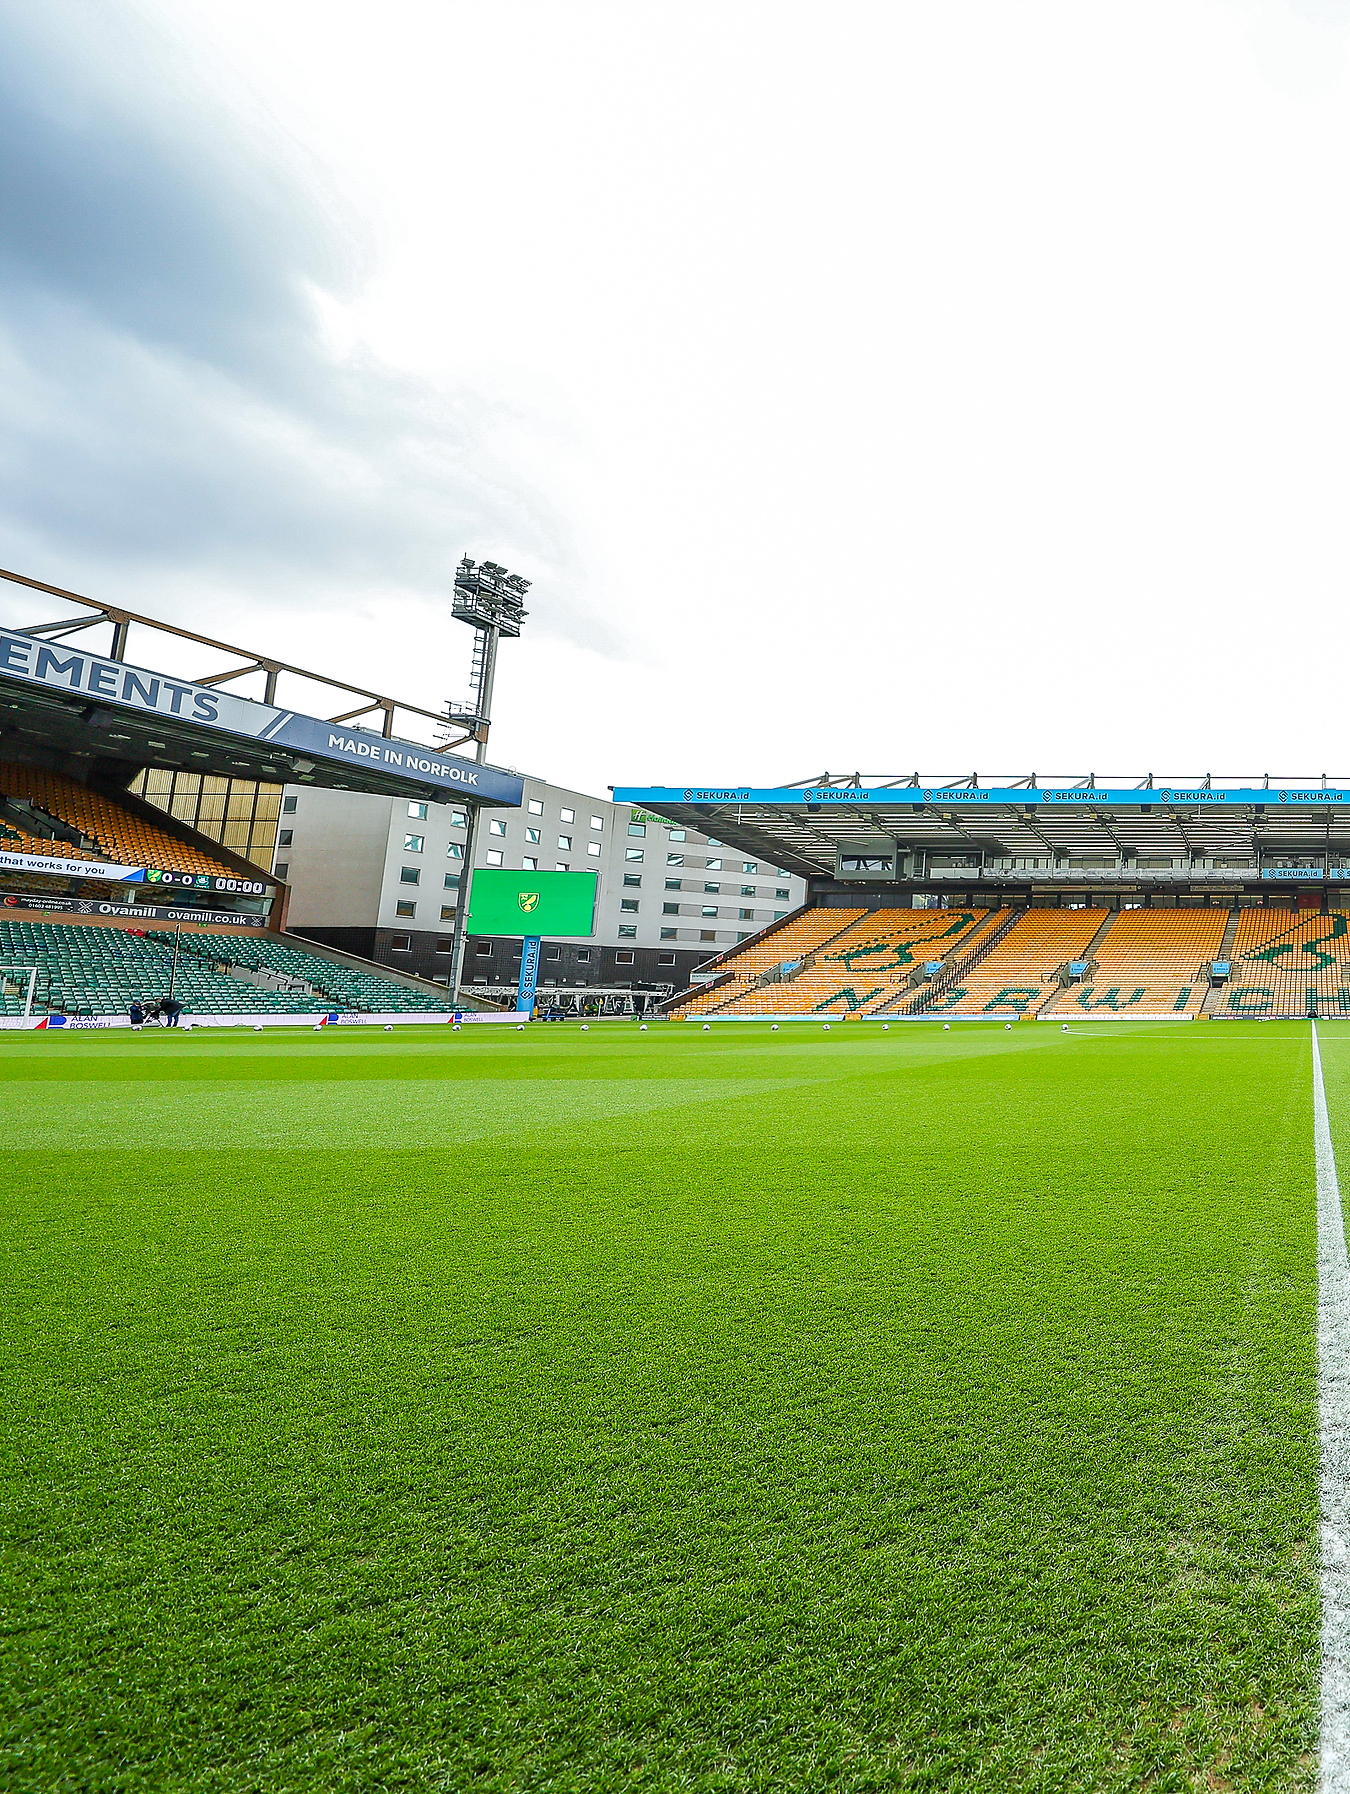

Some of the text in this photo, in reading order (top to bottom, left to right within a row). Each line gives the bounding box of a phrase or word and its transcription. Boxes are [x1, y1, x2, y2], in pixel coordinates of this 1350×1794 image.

[0, 636, 220, 722] EMENTS
[328, 734, 478, 786] MADE IN NORFOLK
[697, 791, 749, 800] SEKURA.id
[816, 792, 868, 800] SEKURA.id
[936, 792, 988, 800] SEKURA.id
[1055, 792, 1108, 800] SEKURA.id
[1173, 792, 1225, 800] SEKURA.id
[1291, 792, 1342, 800] SEKURA.id
[0, 856, 105, 875] that works for you
[216, 878, 263, 894] 00:00
[99, 904, 156, 918] Ovamill
[168, 911, 246, 925] ovamill.co.uk
[524, 942, 537, 988] SEKURA.id
